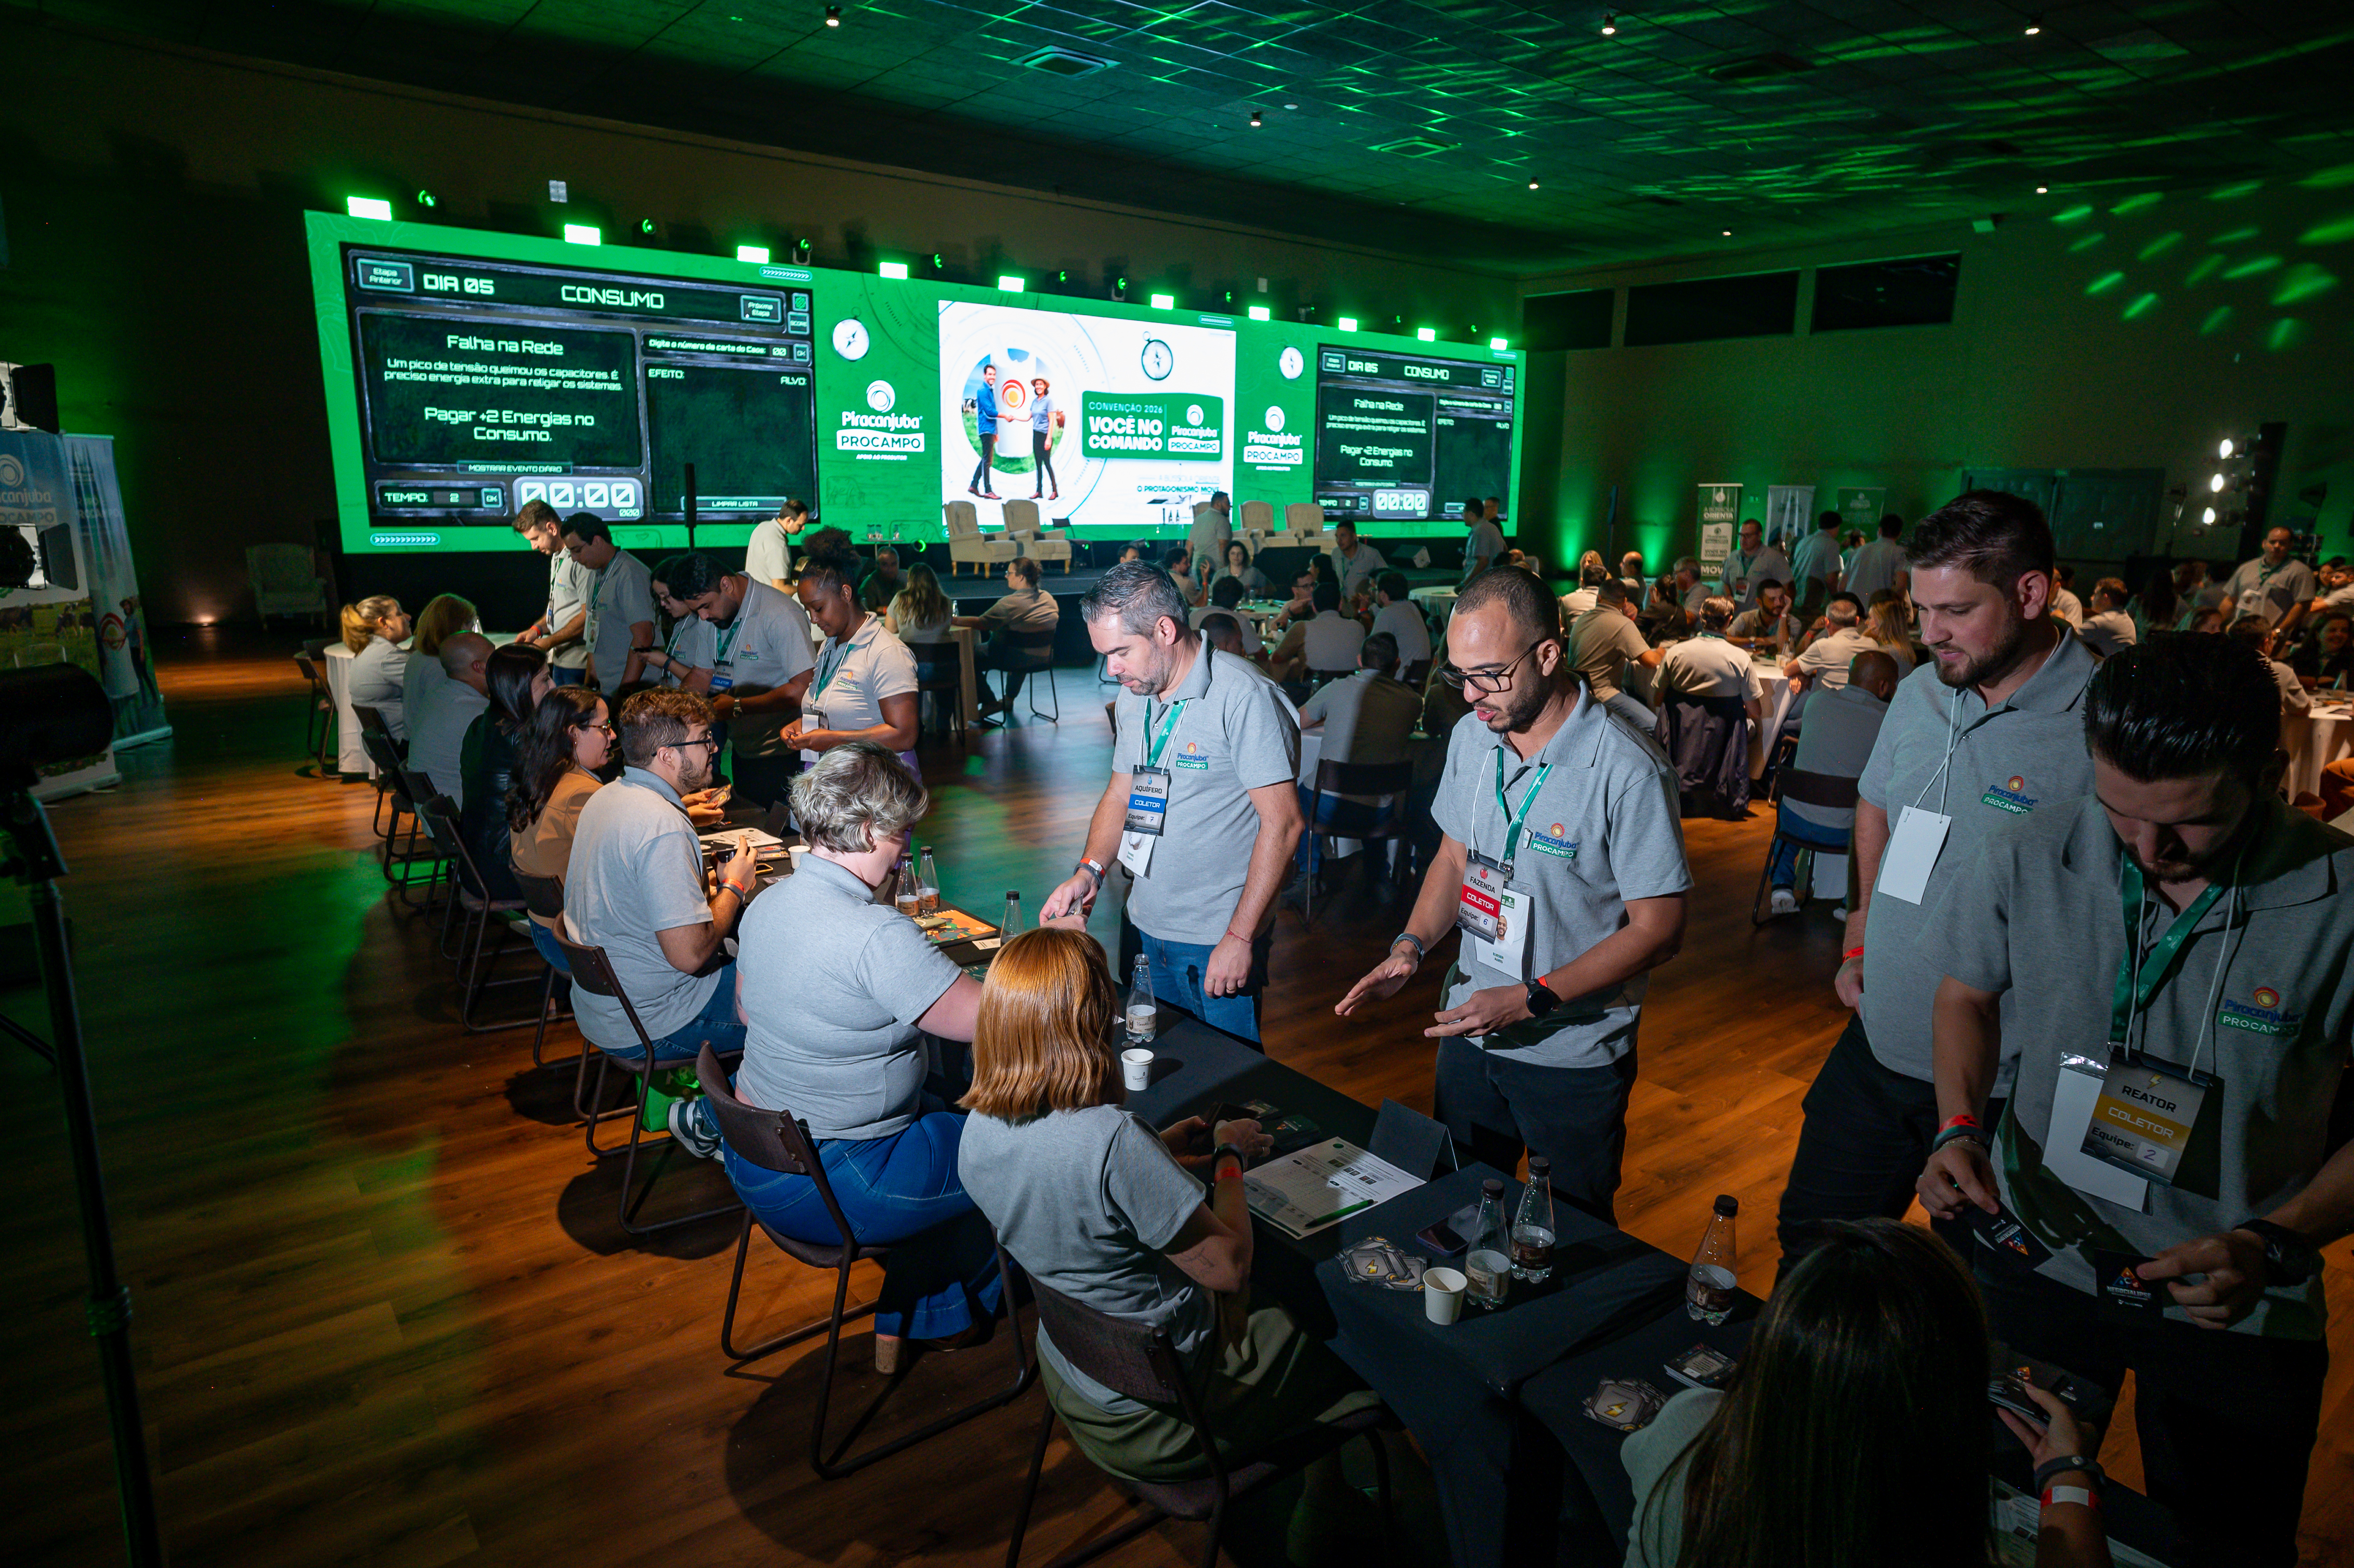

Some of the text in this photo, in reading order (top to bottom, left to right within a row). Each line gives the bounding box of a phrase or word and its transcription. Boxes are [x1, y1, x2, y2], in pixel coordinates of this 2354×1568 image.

[369, 275, 403, 285] Anterior
[372, 267, 398, 277] Etapa
[423, 273, 495, 295] DIA 05
[561, 285, 664, 309] CONSUMO
[447, 334, 564, 355] Falha na Rede
[649, 338, 671, 349] Digite
[772, 347, 787, 357] 00
[387, 358, 408, 369] Um
[409, 359, 433, 371] pico
[433, 360, 449, 371] de
[449, 361, 488, 373] tensão
[489, 364, 533, 376] queimou
[534, 368, 548, 376] os
[1404, 365, 1449, 381] CONSUMO
[384, 370, 427, 382] preciso
[428, 373, 470, 385] energia
[472, 374, 501, 385] extra
[502, 377, 527, 387] para
[528, 377, 561, 389] religar
[562, 380, 576, 389] os
[1088, 401, 1163, 414] CONVENÇÃO 2026
[424, 406, 595, 428] Pagar +2 Energias no
[842, 411, 920, 432] Piracanjuba
[1088, 415, 1163, 436] VOCÊ NO
[473, 426, 553, 442] Consumo.
[1171, 425, 1218, 439] Piracanjuba
[1248, 430, 1301, 448] Piracanjuba
[841, 436, 921, 449] PROCAMPO
[1088, 434, 1163, 451] COMANDO
[1171, 442, 1217, 451] PROCAMPO
[1247, 451, 1300, 462] PROCAMPO
[0, 488, 53, 507] canjuba
[449, 492, 460, 503] 2
[1375, 492, 1427, 511] 00:00
[1700, 565, 1723, 575] MOV
[1177, 753, 1208, 762] Piracanjuba
[1134, 785, 1162, 794] AQUÍFERO
[1989, 784, 2034, 806] Piracanjuba
[1134, 799, 1160, 809] COLETOR
[1983, 796, 2029, 815] PROCAMPO
[1534, 831, 1577, 850] Piracanjuba
[1533, 842, 1574, 857] PROCAMPO
[1470, 876, 1496, 894] FAZENDA
[1467, 892, 1494, 911] COLETOR
[1460, 907, 1479, 921] Equipe:
[2122, 1085, 2177, 1113] REATOR
[2108, 1106, 2175, 1139] COLETOR
[2091, 1127, 2156, 1161] Equipe: 2
